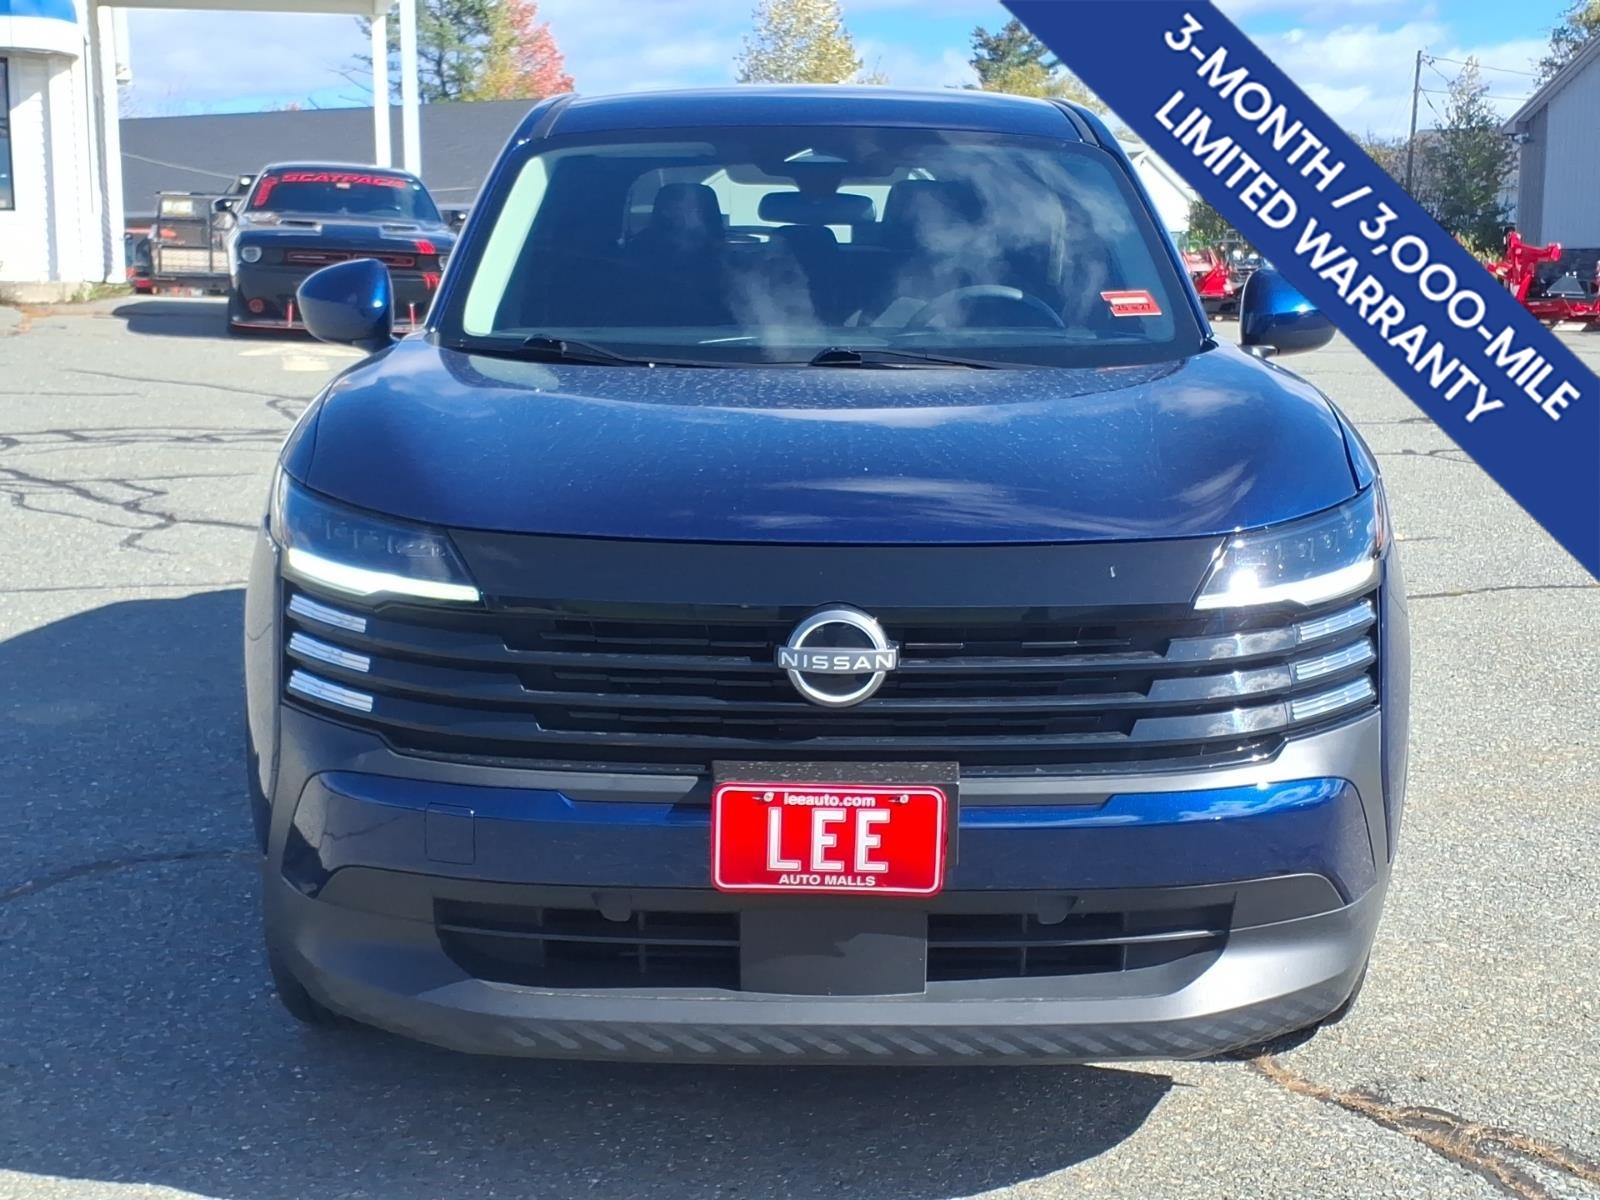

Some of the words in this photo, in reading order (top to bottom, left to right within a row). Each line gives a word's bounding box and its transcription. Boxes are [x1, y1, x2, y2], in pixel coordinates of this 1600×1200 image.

[781, 651, 893, 671] NISSAN
[784, 792, 876, 807] leeauto.com
[767, 807, 890, 873] LEE
[778, 874, 821, 886] AUTO
[823, 874, 877, 887] MALLS
